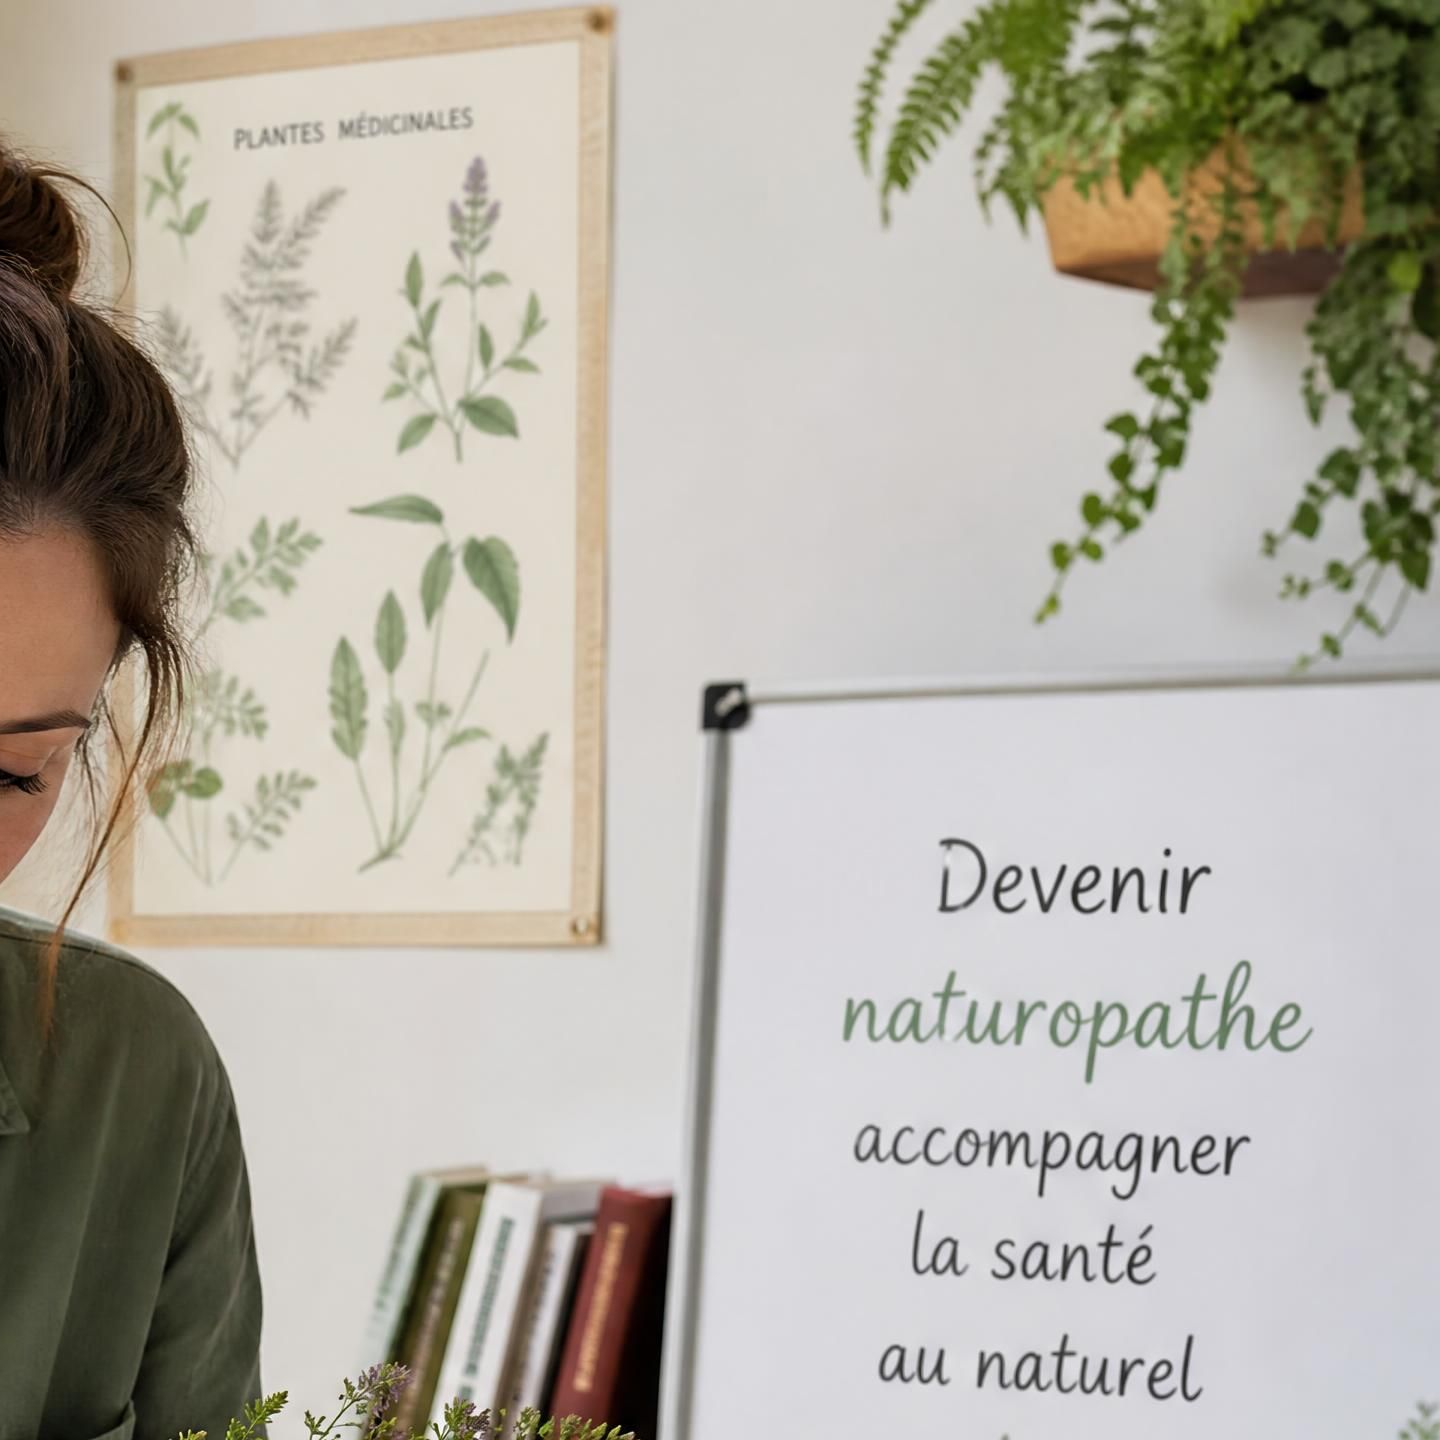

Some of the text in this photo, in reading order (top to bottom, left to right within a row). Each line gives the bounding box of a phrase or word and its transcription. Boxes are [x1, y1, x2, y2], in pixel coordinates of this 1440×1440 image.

[233, 106, 474, 151] PLANTES MÉDICINALES
[937, 837, 1212, 915] Devenir
[841, 959, 1314, 1085] naturopathe
[852, 1123, 1252, 1201] accompagner
[911, 1209, 1157, 1286] la santé
[878, 1333, 1204, 1403] au naturel
